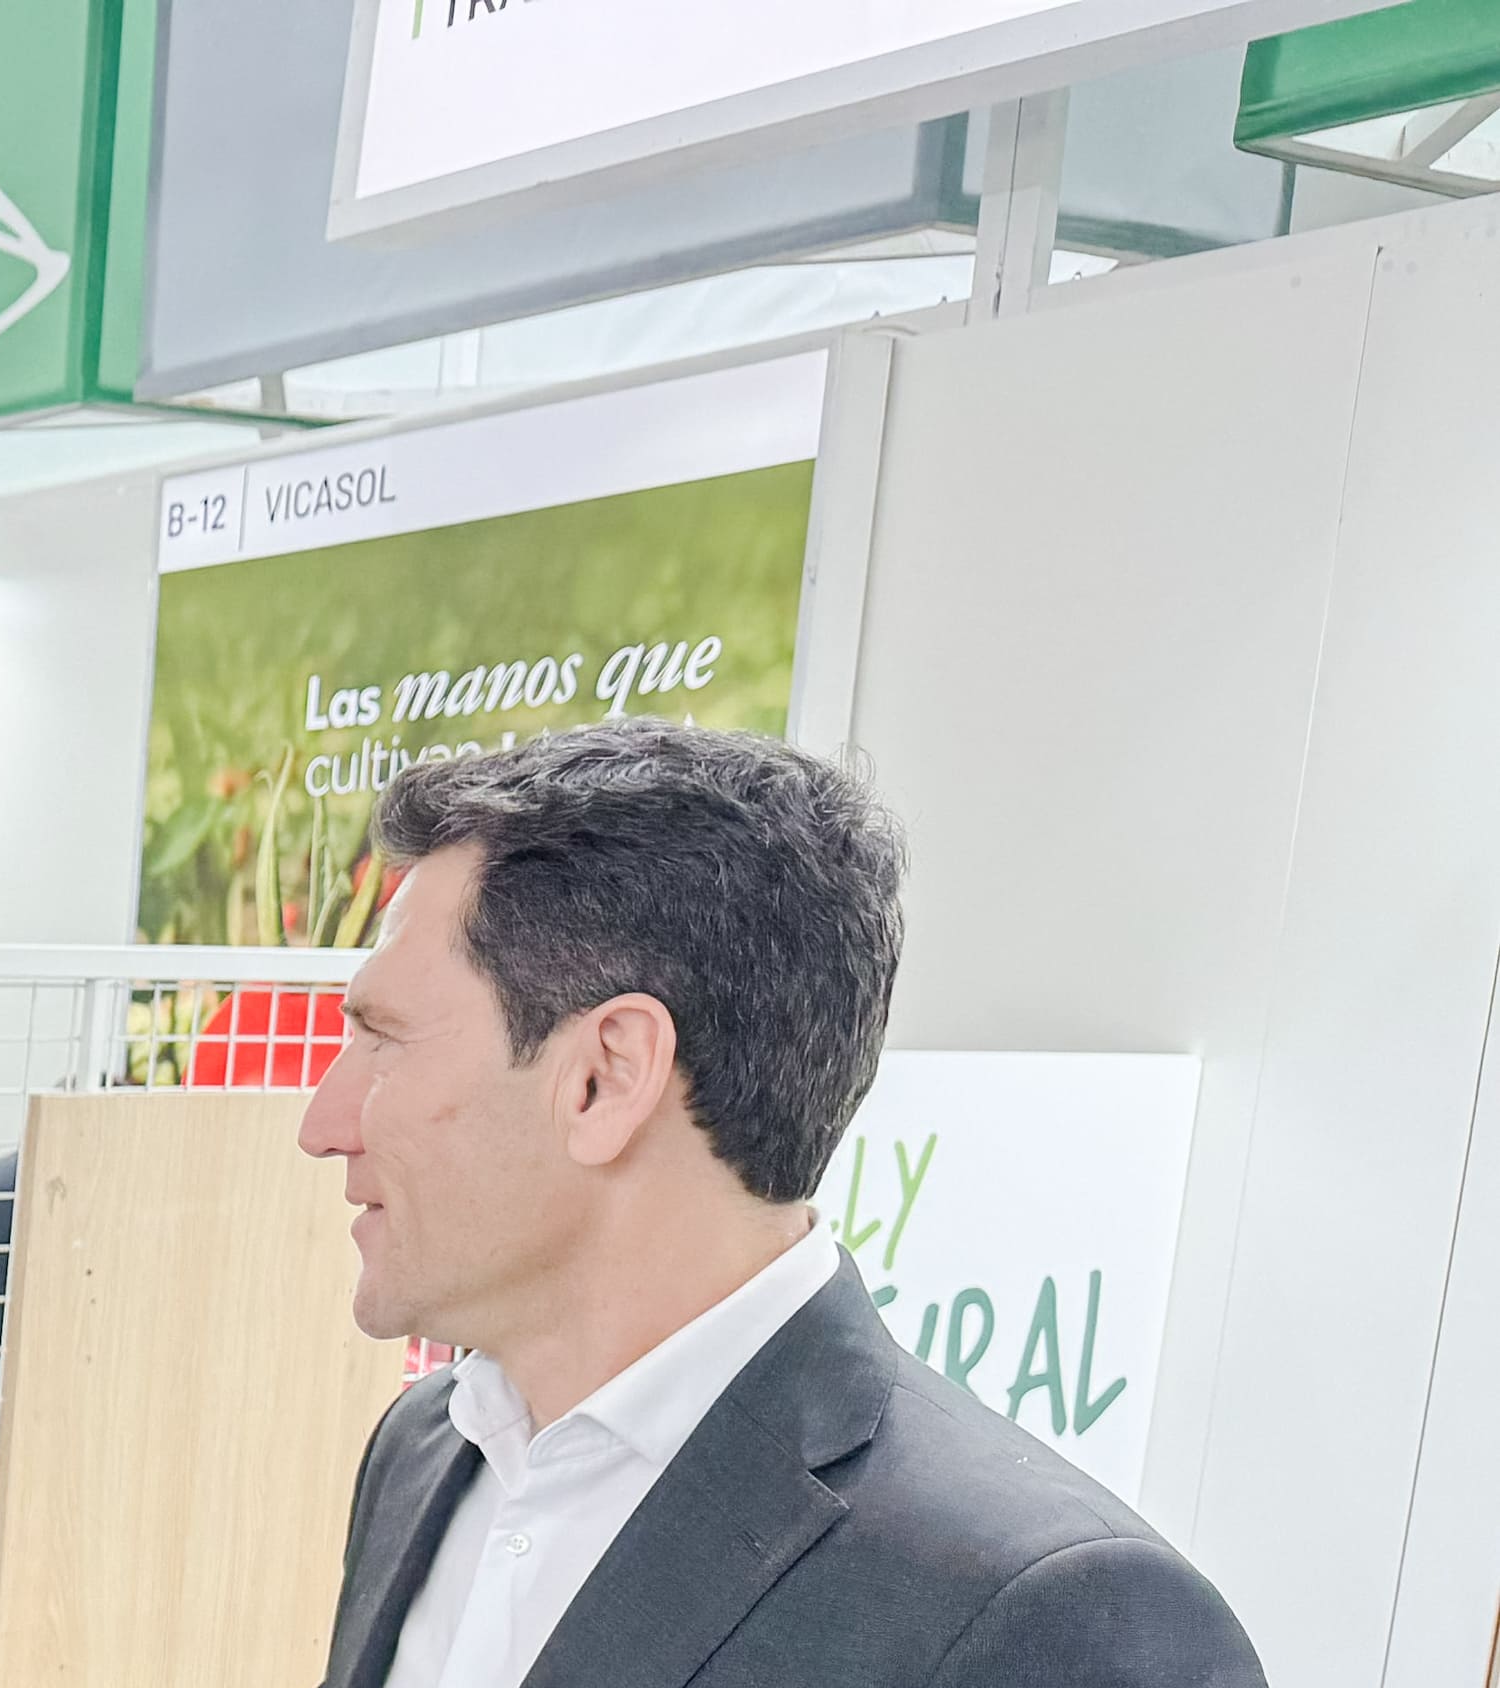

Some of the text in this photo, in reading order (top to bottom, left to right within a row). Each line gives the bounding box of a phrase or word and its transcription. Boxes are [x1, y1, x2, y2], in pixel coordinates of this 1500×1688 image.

[167, 464, 397, 539] B-12 VICASOL
[304, 635, 724, 731] Las manos que
